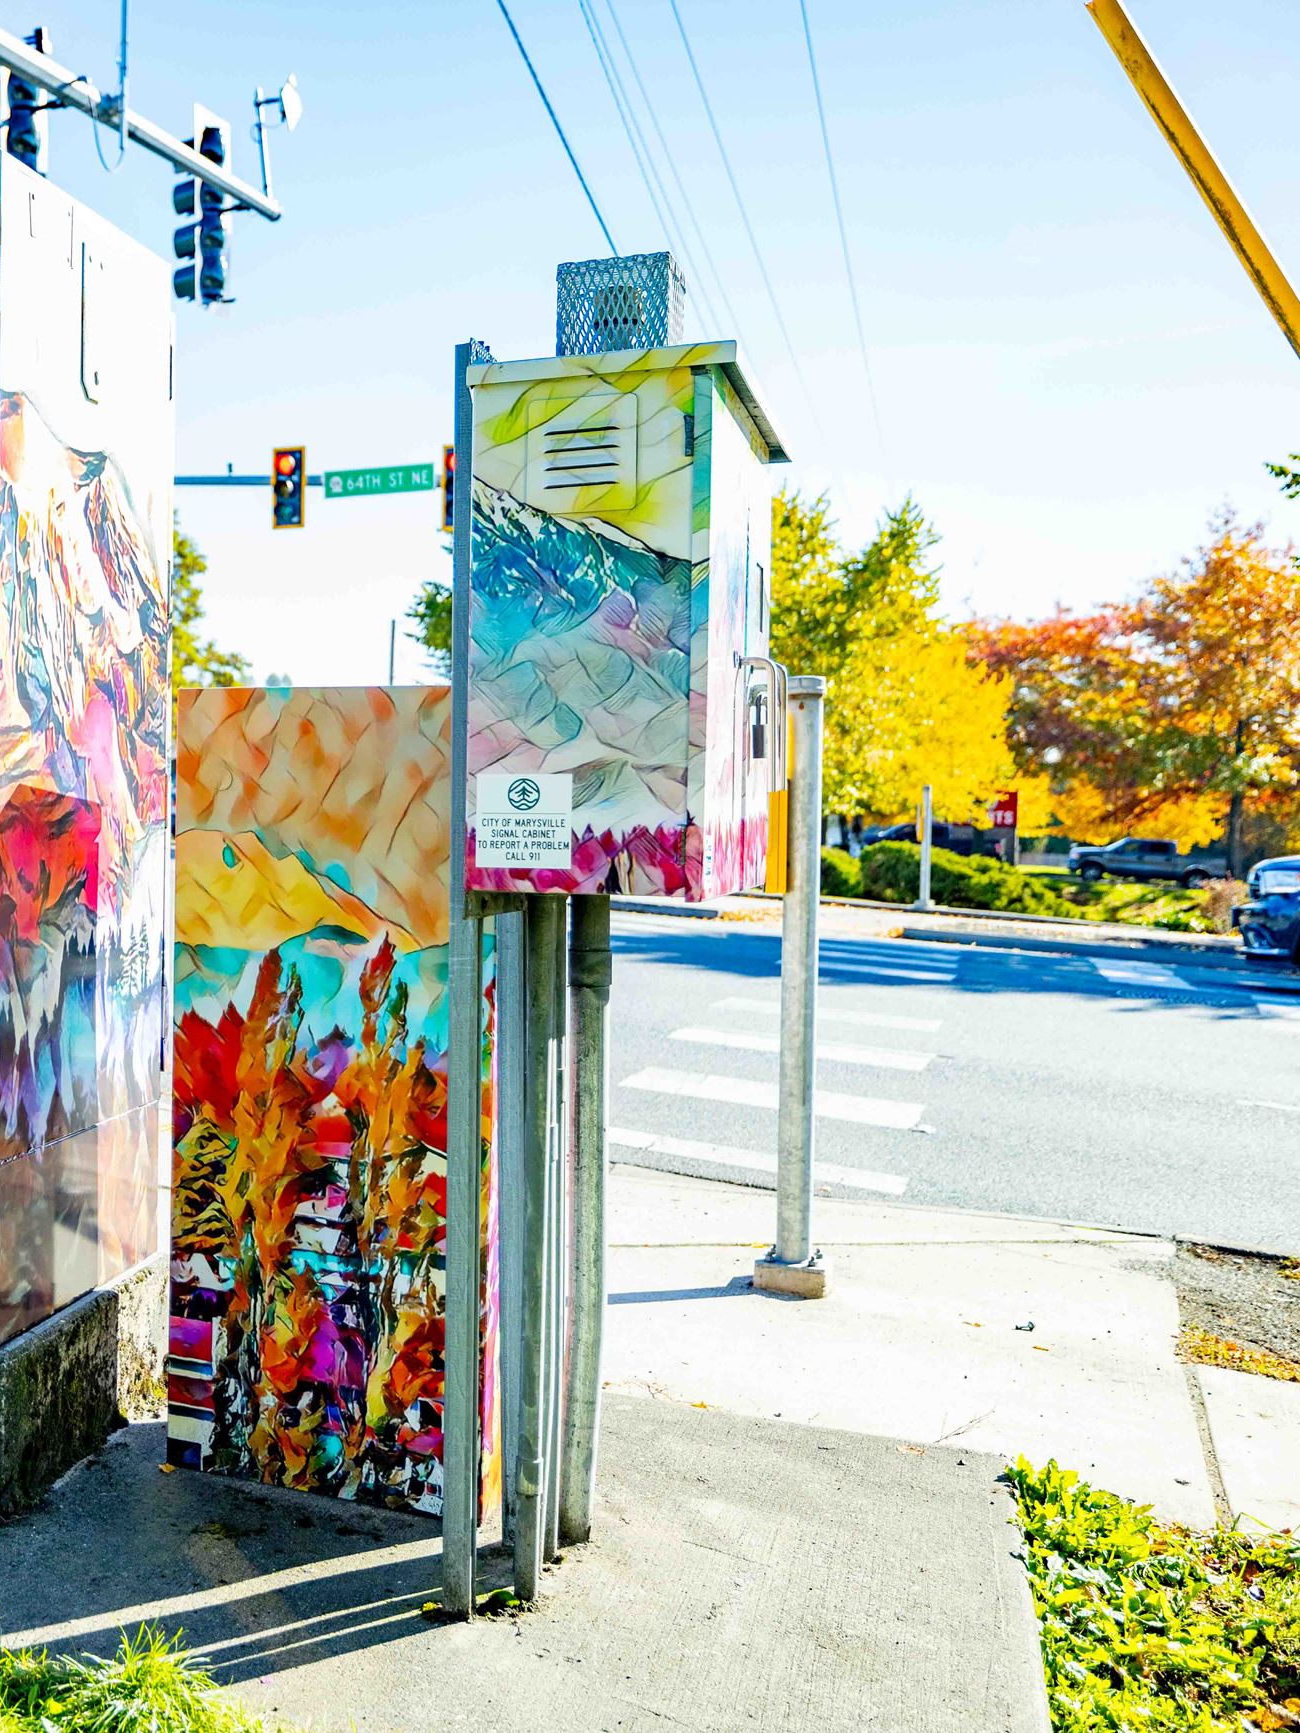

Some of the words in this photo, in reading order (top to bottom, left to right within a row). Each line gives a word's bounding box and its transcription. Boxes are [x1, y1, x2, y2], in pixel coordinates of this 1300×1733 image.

[347, 474, 381, 491] 64TH
[389, 472, 404, 487] ST
[411, 470, 429, 485] NE
[481, 818, 499, 827] CITY
[501, 818, 512, 827] OF
[514, 818, 566, 828] MARYSVILLE
[491, 829, 519, 838] SIGNAL
[522, 829, 556, 838] CABINET
[478, 840, 488, 849] TO
[489, 840, 520, 849] REPORT
[523, 840, 529, 849] A
[531, 840, 570, 850] PROBLEM
[505, 851, 526, 861] CALL
[529, 851, 541, 861] 911
